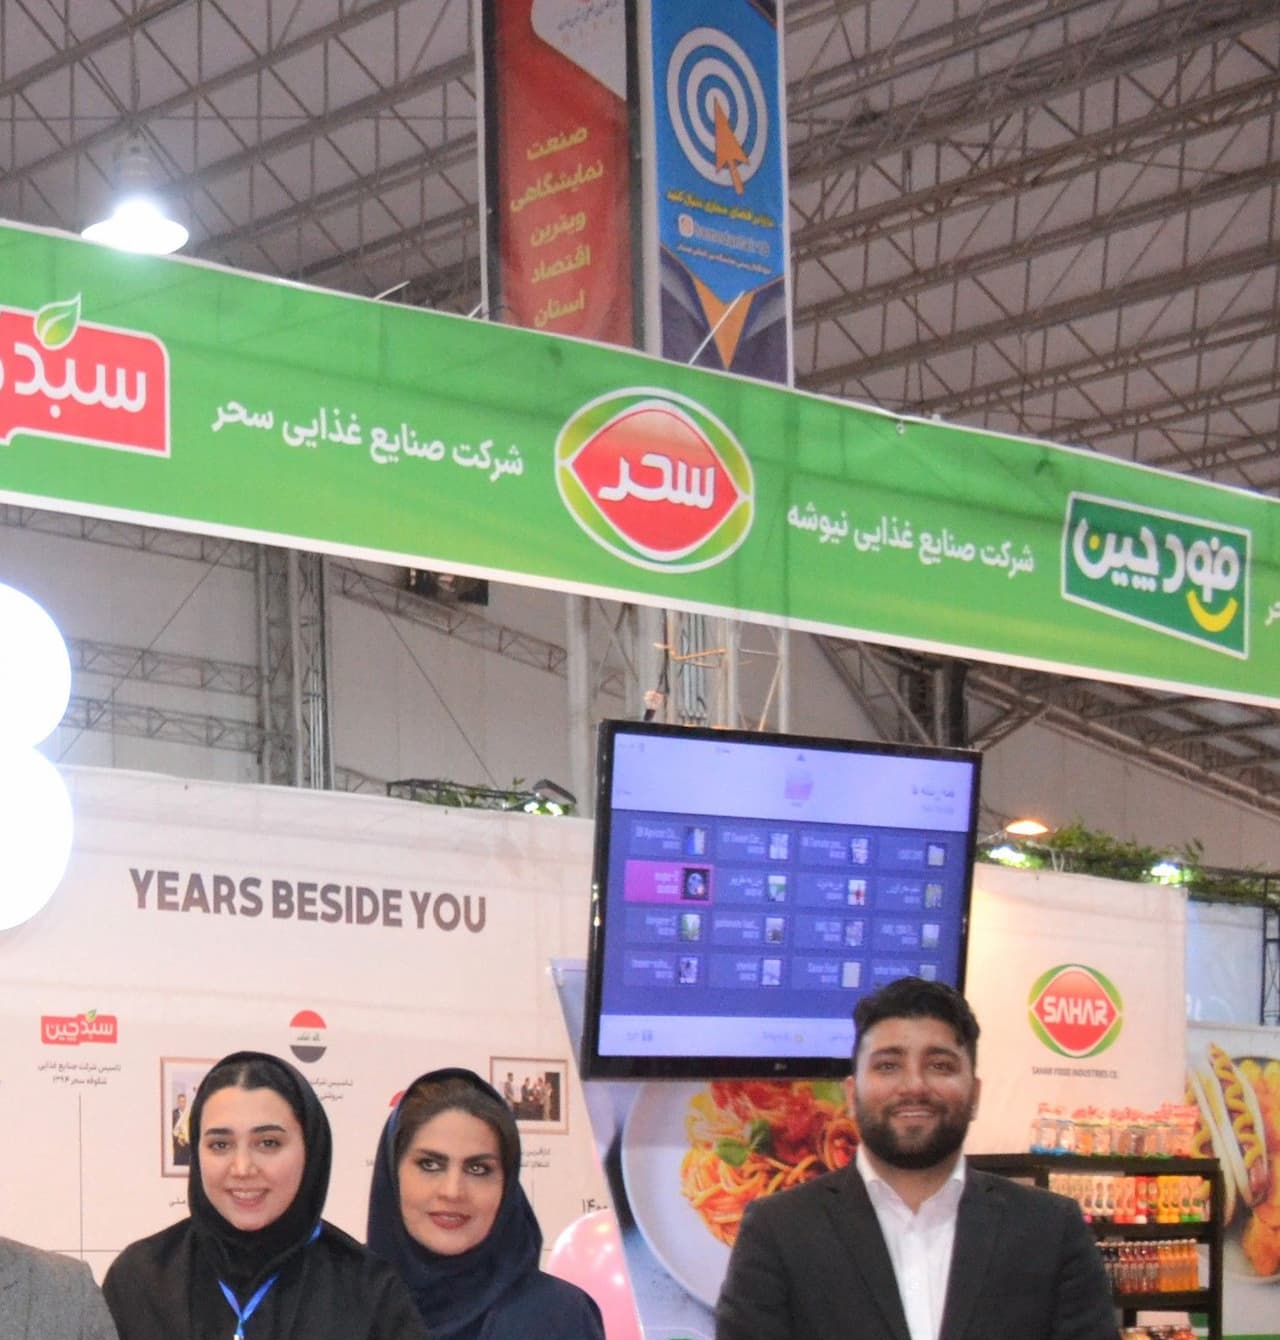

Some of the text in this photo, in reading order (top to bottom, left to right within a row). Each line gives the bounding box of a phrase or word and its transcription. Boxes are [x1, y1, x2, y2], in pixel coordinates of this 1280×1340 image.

[526, 126, 589, 162] صنعت
[509, 160, 605, 214] نمایشگاهی
[530, 209, 587, 248] ویترین
[530, 244, 591, 285] اقتصاد
[533, 290, 586, 330] استان
[210, 400, 525, 484] شرکت صنایع غذایی سحر
[597, 451, 716, 511] سحر
[787, 501, 1036, 579] شرکت صنایع غذایی نیوشه
[128, 867, 487, 934] YEARS BESIDE YOU
[1042, 996, 1109, 1026] SAHAR
